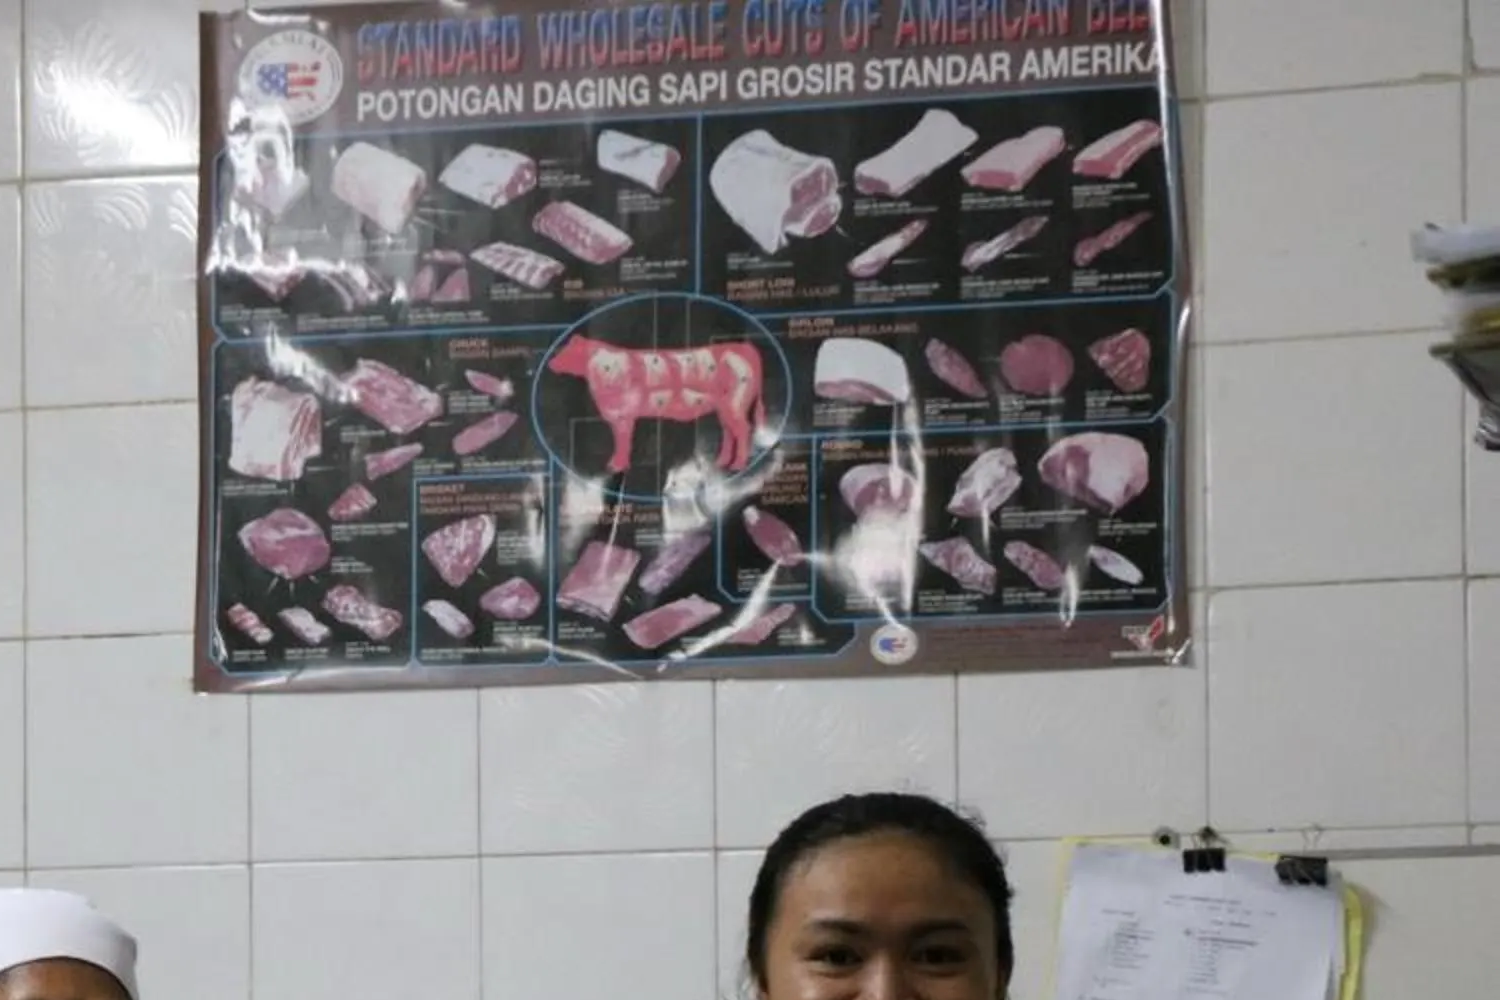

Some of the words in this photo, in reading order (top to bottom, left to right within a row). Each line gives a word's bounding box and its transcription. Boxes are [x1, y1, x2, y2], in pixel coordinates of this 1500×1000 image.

[356, 15, 523, 84] STANDARD
[536, 0, 728, 72] WHOLESALE
[741, 0, 827, 58] CUTS
[839, 0, 882, 53] OF
[893, 0, 1071, 47] AMERICAN
[356, 82, 523, 122] POTONGAN
[532, 73, 651, 113] DAGING
[658, 69, 728, 104] SAPI
[735, 62, 856, 100] GROSIR
[863, 51, 1012, 91] STANDAR
[1018, 41, 1168, 81] AMERIKA
